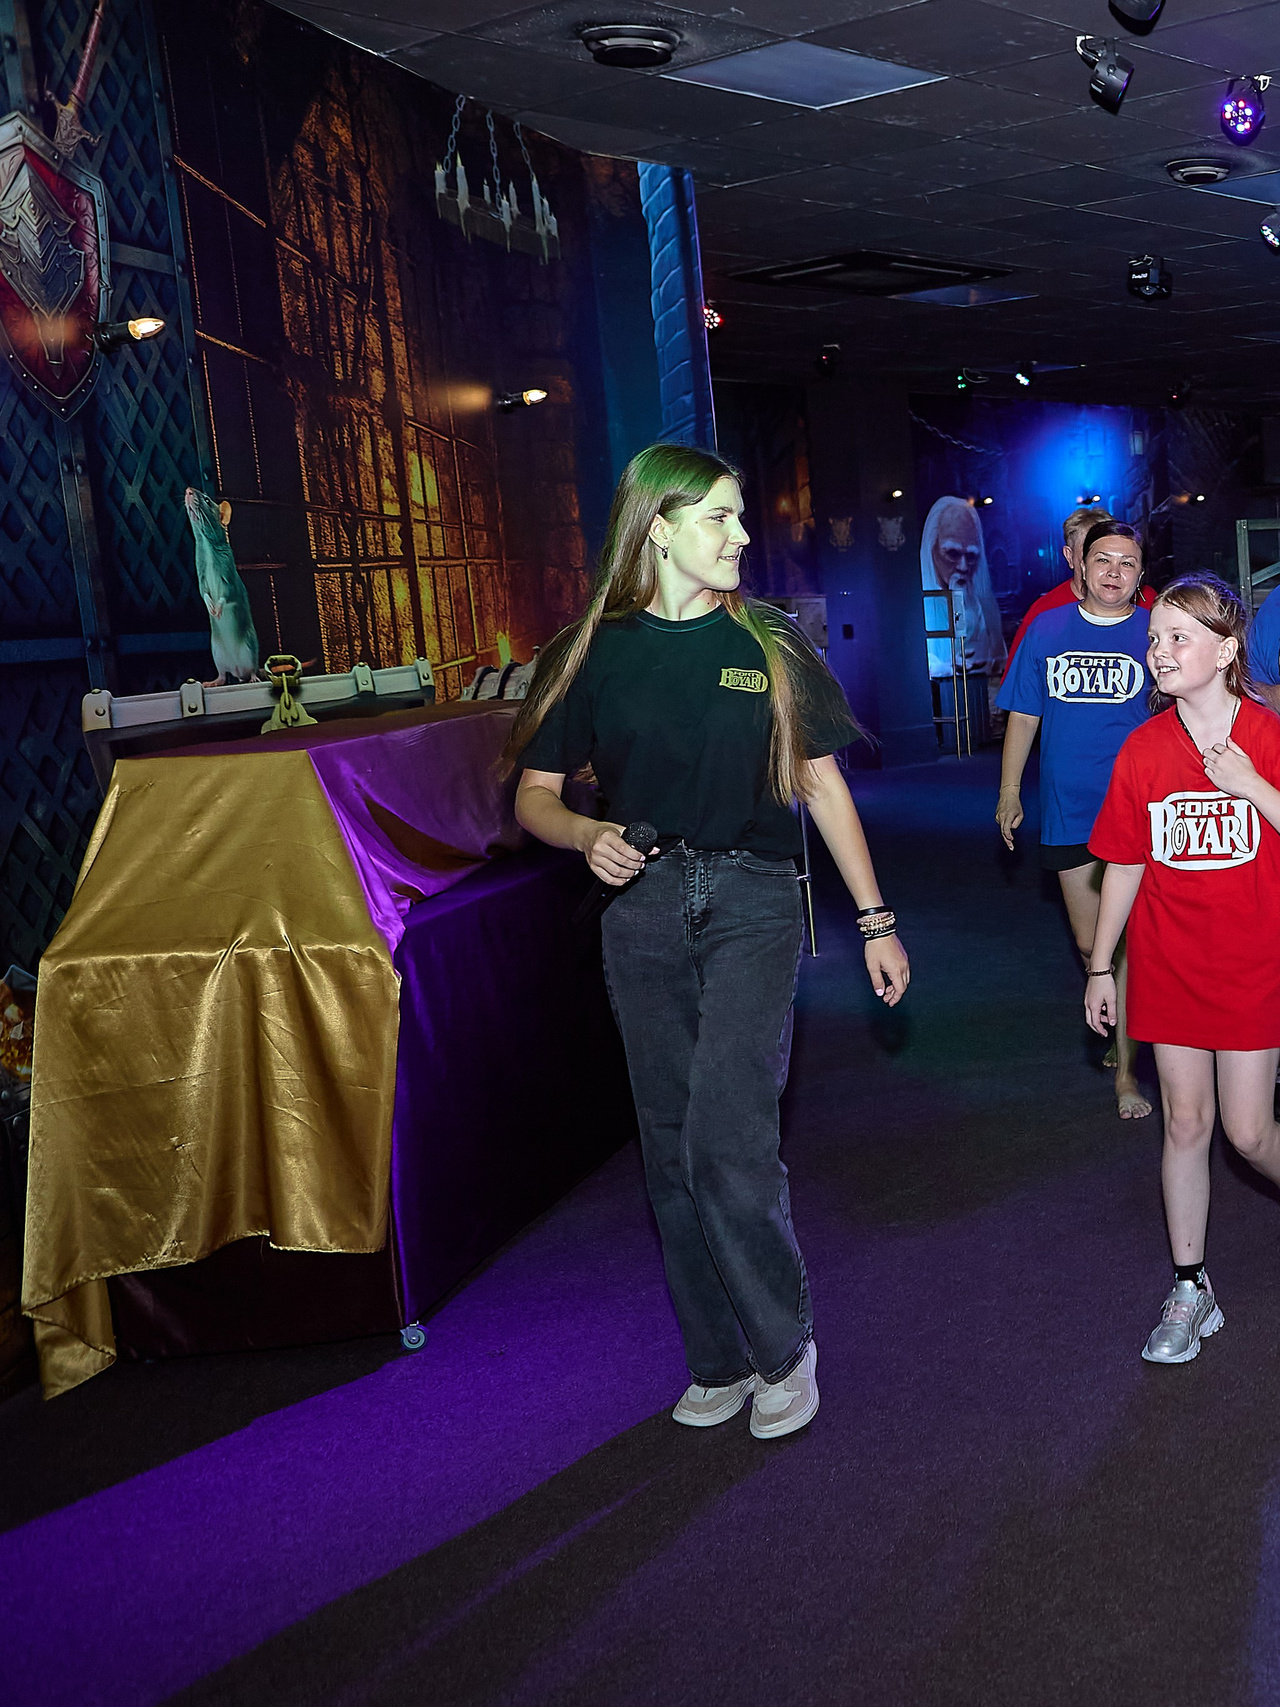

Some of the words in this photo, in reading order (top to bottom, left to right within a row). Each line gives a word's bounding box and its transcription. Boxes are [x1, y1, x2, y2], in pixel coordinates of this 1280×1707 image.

[1070, 657, 1118, 667] FORT
[719, 668, 768, 692] BOYARD
[1046, 656, 1145, 700] BOYARD
[1177, 799, 1231, 816] FORT
[1147, 798, 1261, 862] BOYARD
